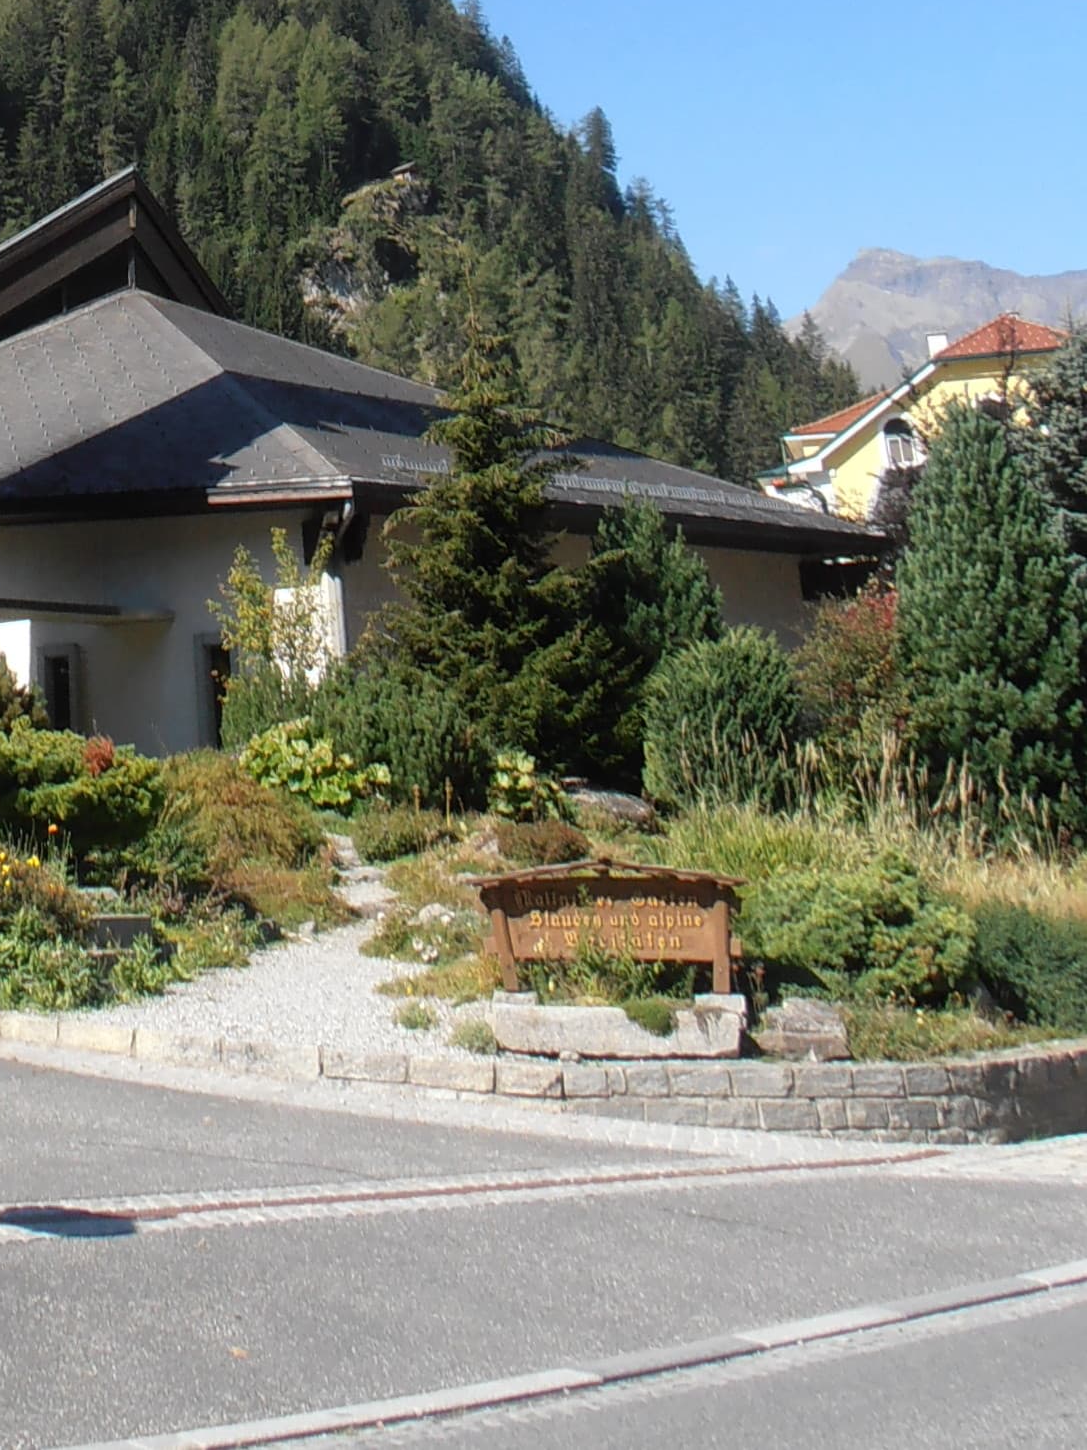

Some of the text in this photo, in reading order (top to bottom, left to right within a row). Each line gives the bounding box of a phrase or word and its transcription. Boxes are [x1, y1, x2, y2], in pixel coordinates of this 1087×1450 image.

[513, 888, 613, 910] Mallnier
[530, 909, 704, 930] Stauden und alpine
